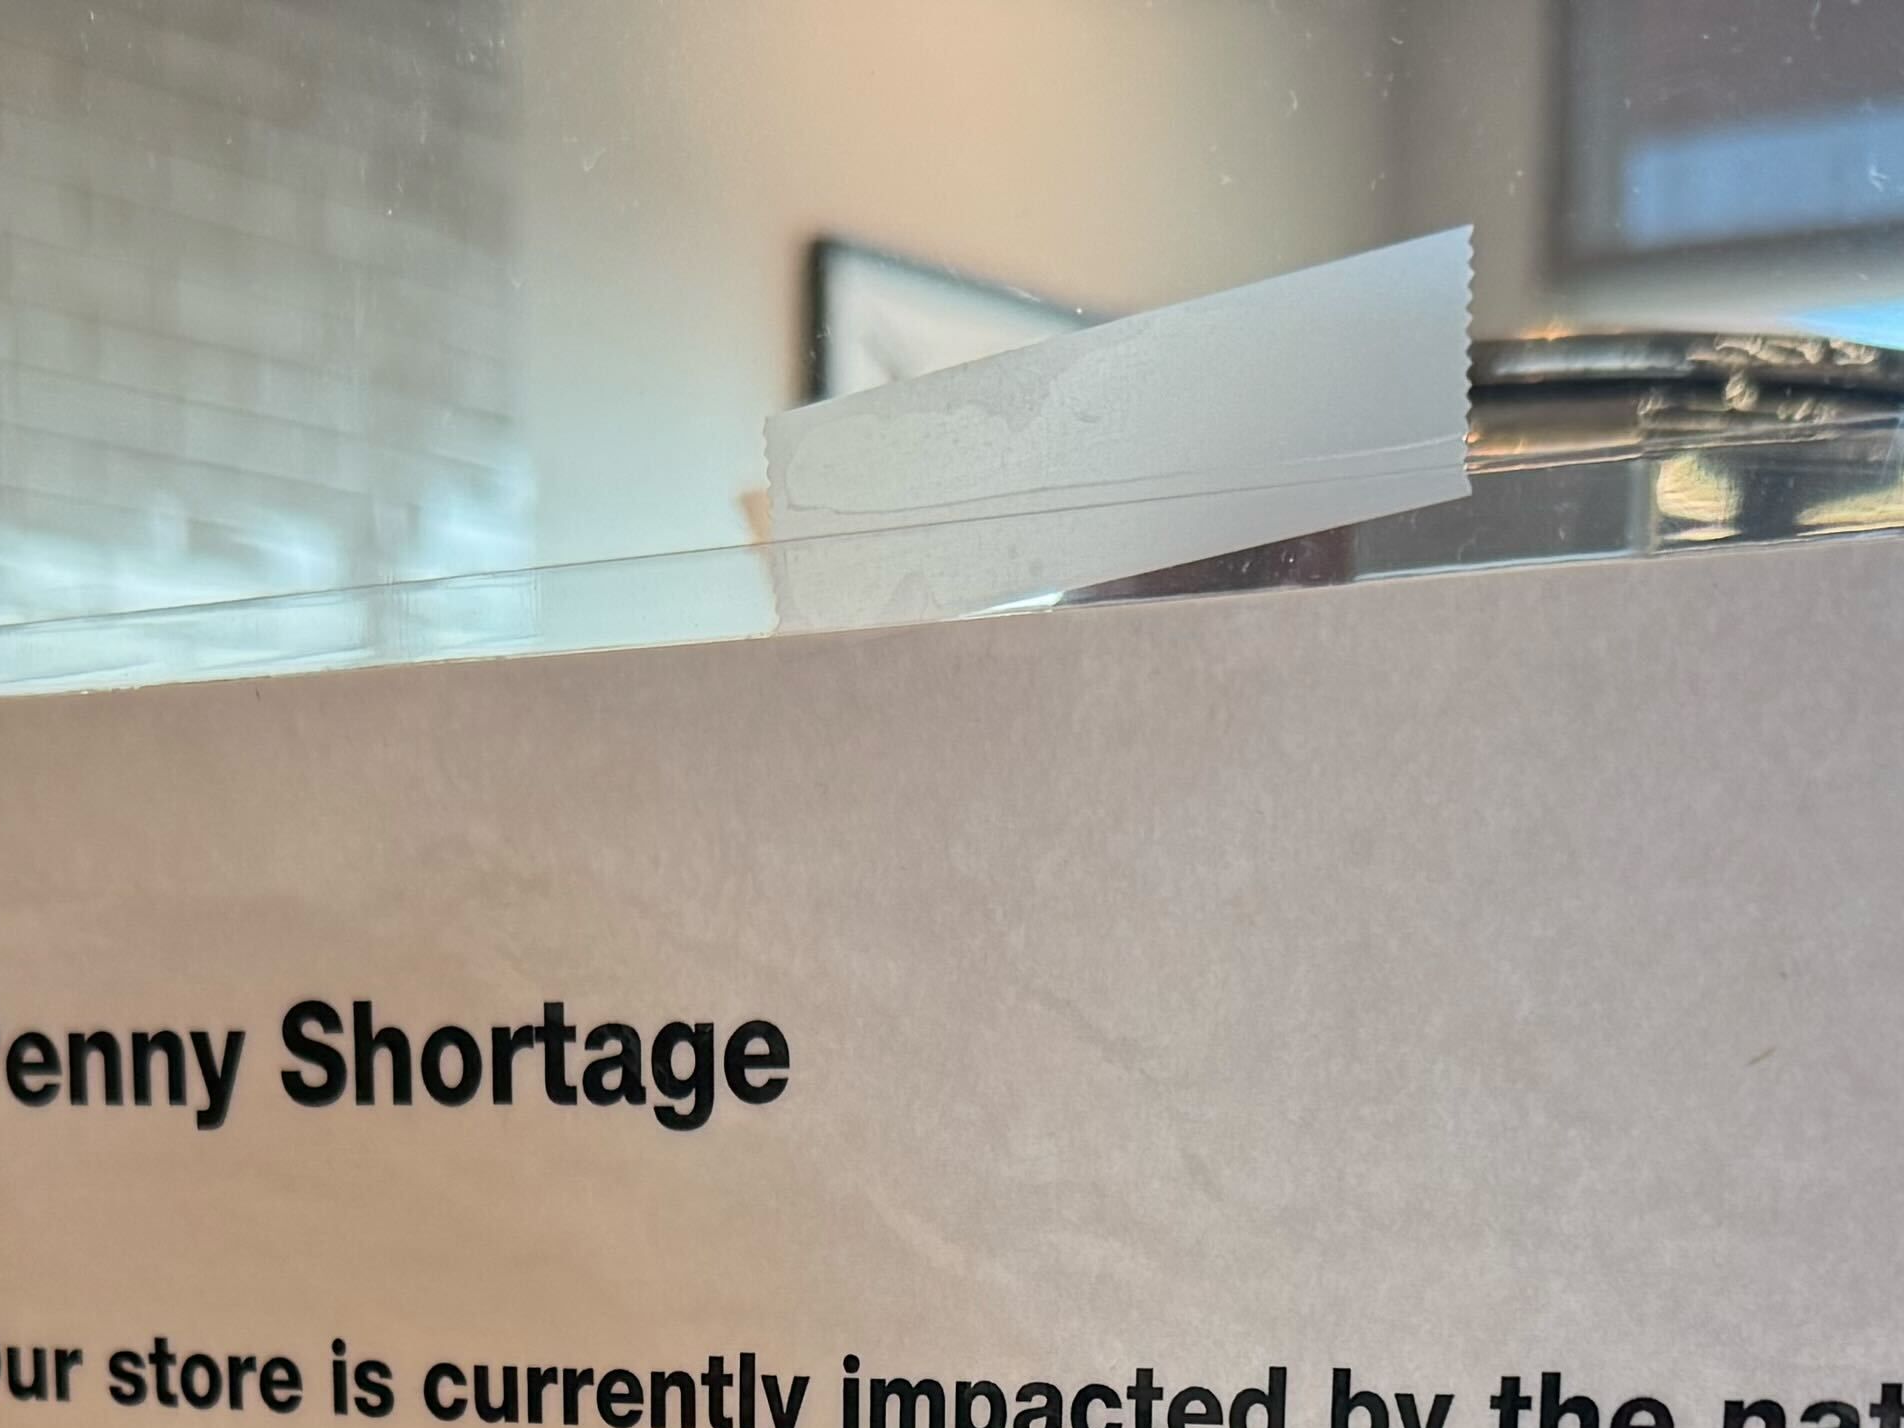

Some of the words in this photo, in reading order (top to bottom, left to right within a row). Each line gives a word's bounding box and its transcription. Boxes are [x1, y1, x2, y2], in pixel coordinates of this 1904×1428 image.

[279, 998, 792, 1133] Shortage
[107, 1335, 304, 1415] store
[330, 1336, 396, 1420] is
